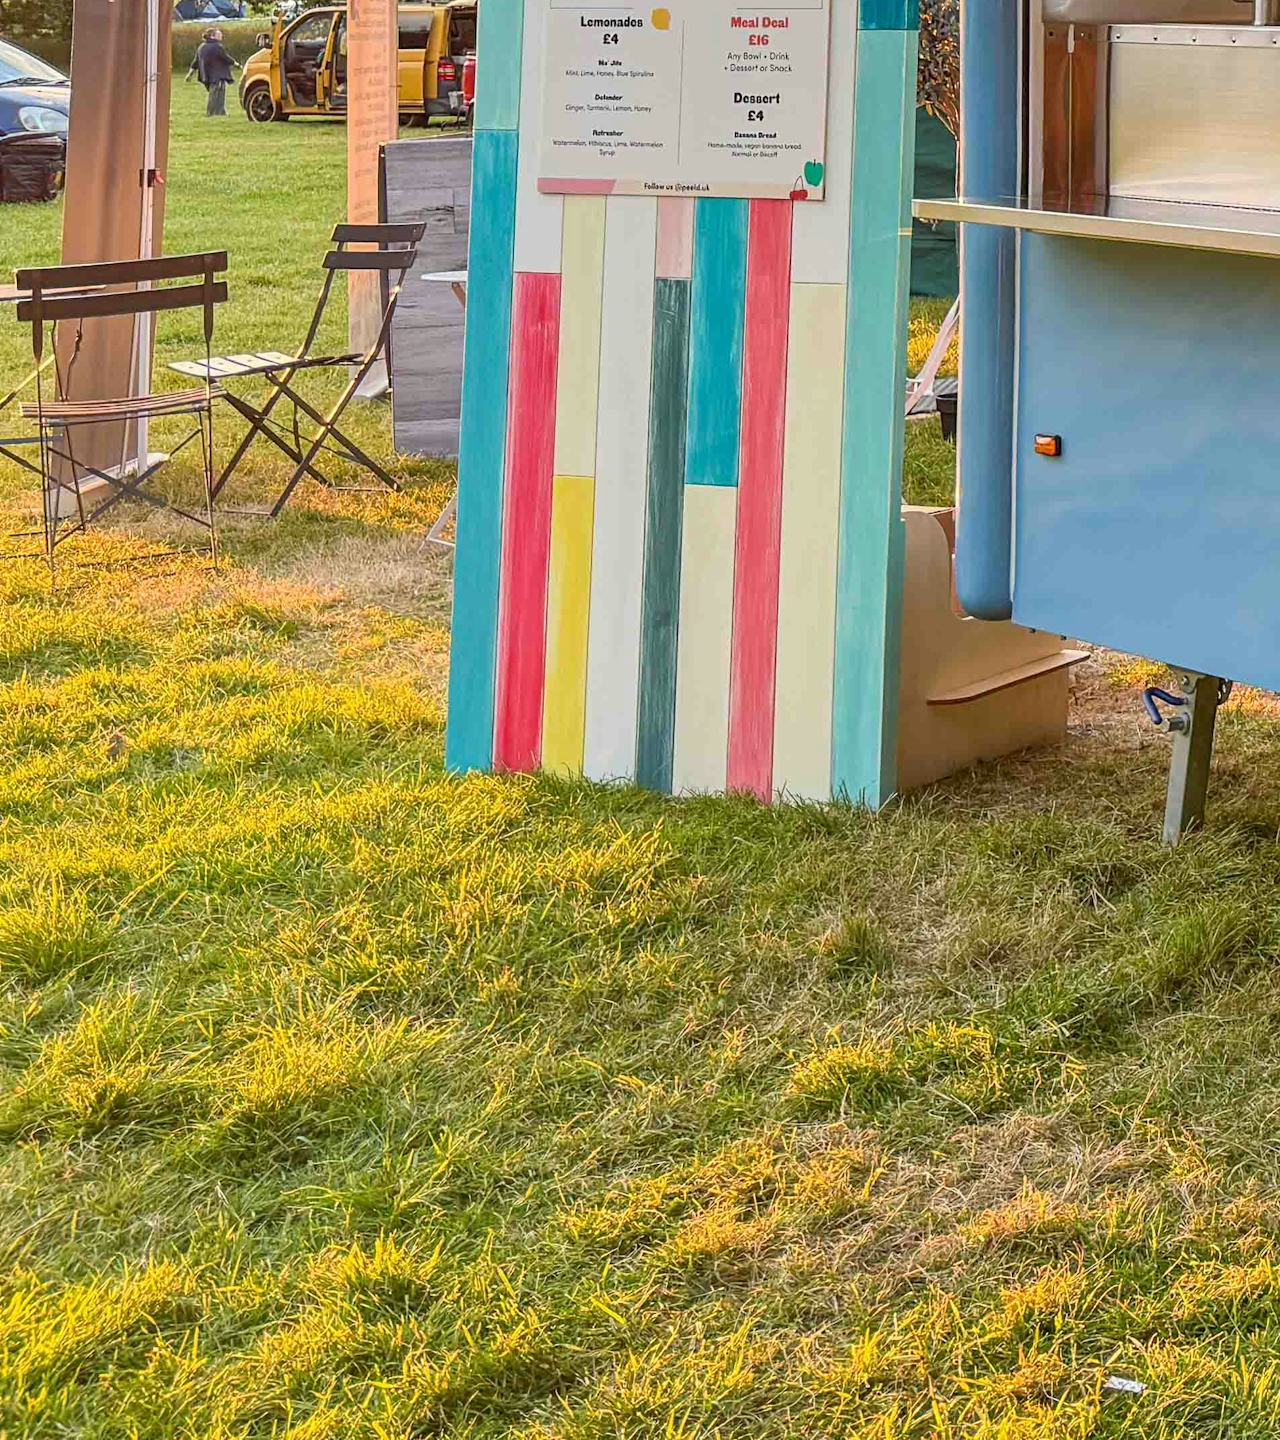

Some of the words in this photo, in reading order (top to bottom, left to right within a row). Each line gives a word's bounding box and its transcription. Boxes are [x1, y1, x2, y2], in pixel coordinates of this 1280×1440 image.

[580, 15, 644, 28] Lemonades
[730, 16, 759, 29] Meal
[761, 16, 789, 28] Deal
[602, 33, 619, 45] £4
[748, 34, 770, 46] £16
[727, 52, 742, 63] Any
[743, 51, 762, 61] Bowl
[769, 51, 790, 61] Drink
[730, 63, 759, 72] Dessert
[769, 64, 793, 73] Snack
[629, 70, 654, 78] Spirulina
[594, 93, 623, 101] Defender
[733, 92, 781, 104] Dessert
[612, 104, 633, 112] Lemon,
[633, 104, 652, 113] Honey
[747, 110, 764, 122] £4
[592, 129, 624, 137] Refresher
[734, 131, 757, 139] Banana
[758, 131, 777, 139] Bread
[629, 140, 664, 148] Watermelon
[644, 182, 665, 190] Follow
